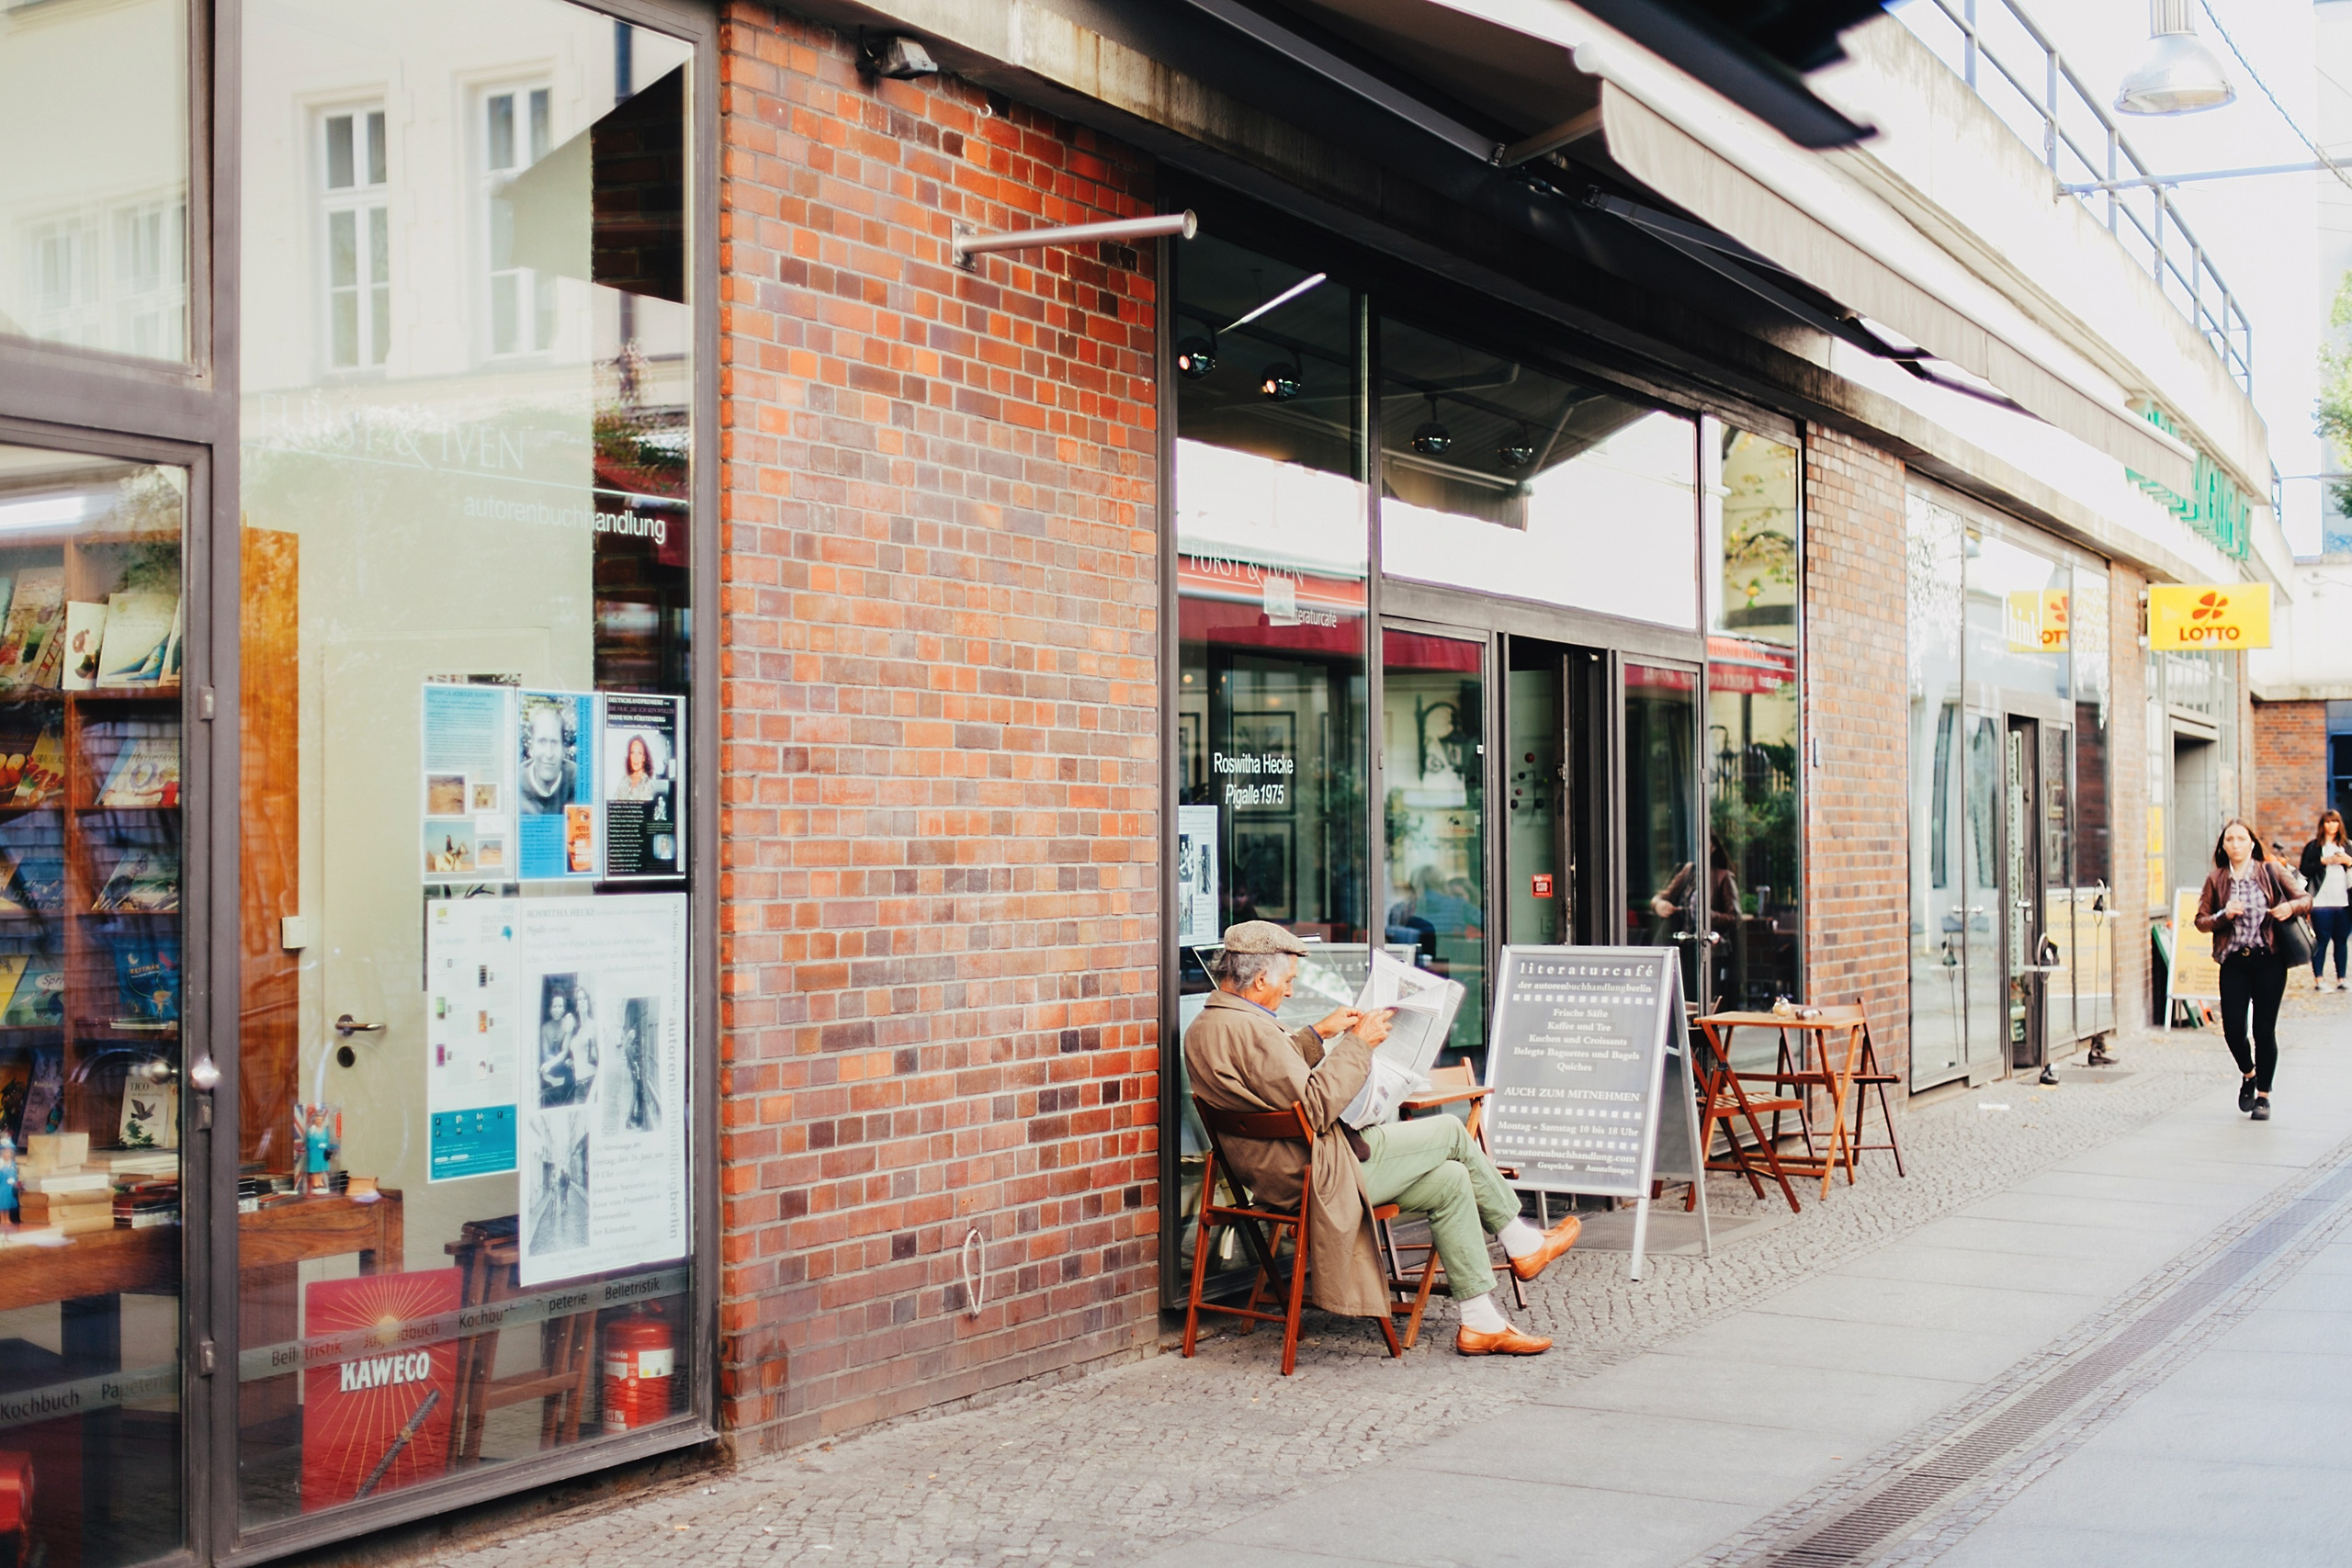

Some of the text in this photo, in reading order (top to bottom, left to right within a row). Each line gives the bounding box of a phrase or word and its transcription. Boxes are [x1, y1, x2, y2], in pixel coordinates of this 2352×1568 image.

[442, 421, 525, 471] IVEN
[464, 495, 666, 545] autorenbuchhandlung
[1268, 555, 1304, 588] IVEN
[2180, 626, 2240, 641] LOTTO
[1214, 752, 1294, 774] Roswitha Hecke
[1226, 784, 1284, 809] Pigalle 1975
[526, 908, 568, 919] ROSWITHA
[570, 908, 595, 917] HECKE
[1520, 963, 1654, 977] literaturcafé
[1518, 981, 1652, 994] der autorenbuchhandlungberlin
[1553, 1009, 1609, 1019] Frische Säfte
[1547, 1021, 1611, 1032] Kaffee und Tee
[1529, 1034, 1627, 1046] Kuchen und Croissants
[1513, 1047, 1640, 1062] Belegte Baguettes und Bagels
[1557, 1062, 1592, 1072] Quiches
[1504, 1087, 1640, 1102] AUCH ZUM MITNEHMEN
[1497, 1121, 1531, 1133] Montag
[1540, 1122, 1577, 1134] Samstag
[1579, 1123, 1589, 1134] 10
[1591, 1125, 1605, 1134] bis
[1608, 1126, 1618, 1136] 18
[1620, 1127, 1639, 1136] Uhr
[1494, 1148, 1636, 1163] www.autorenbuchhandlung.com
[1493, 1159, 1634, 1176] Lesungen Gespräche Ausstellungen
[272, 1342, 342, 1367] Belltristik
[605, 1277, 660, 1301] Belletristik
[340, 1352, 430, 1393] KAWECO
[0, 1388, 80, 1420] Kochbuch
